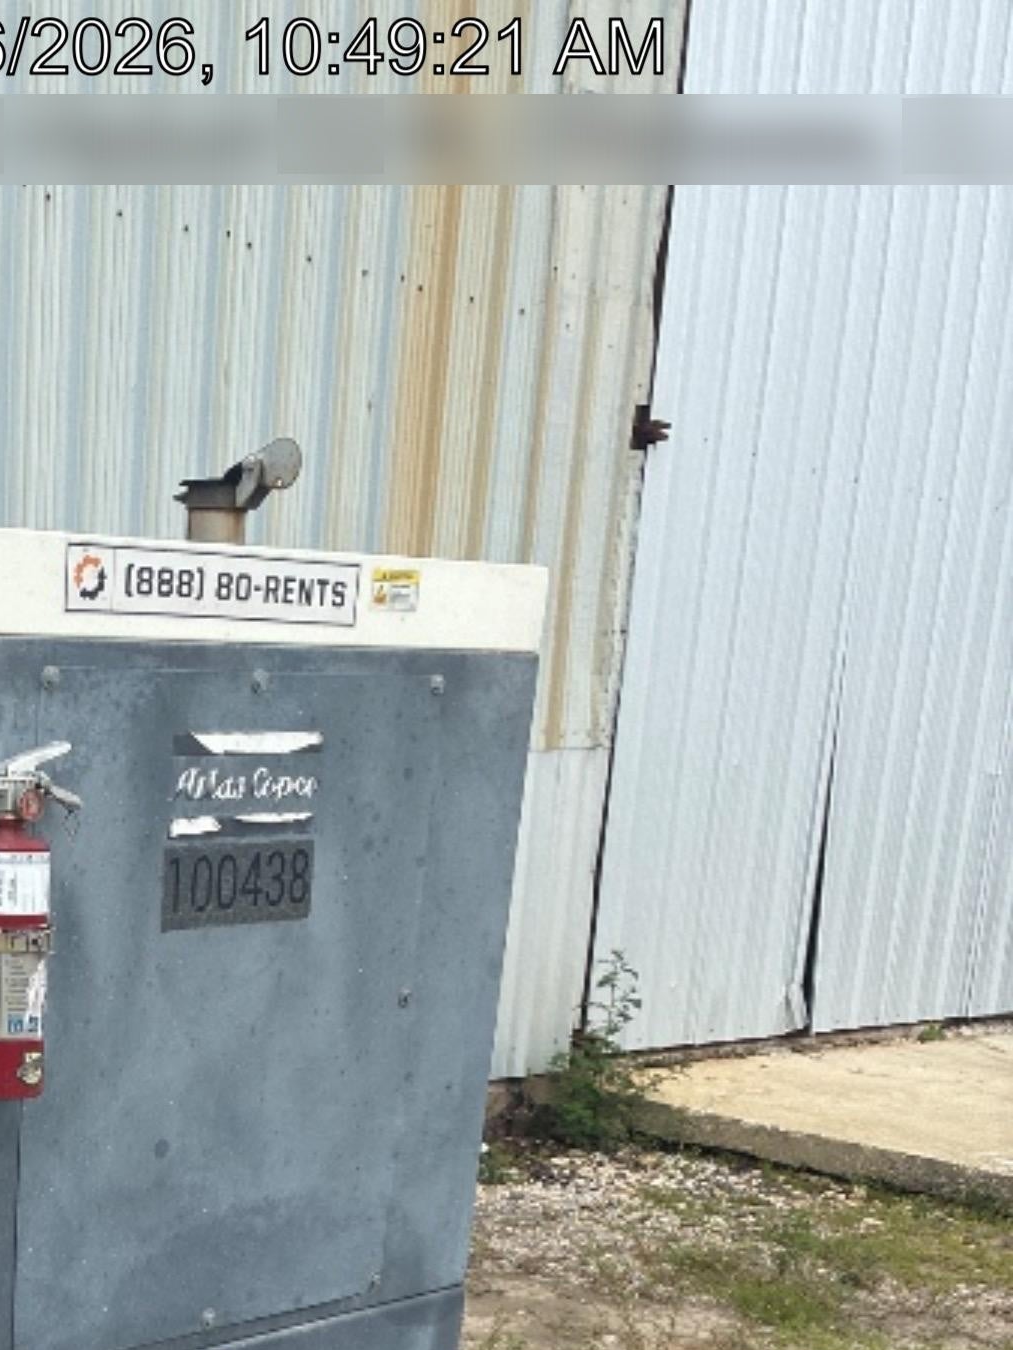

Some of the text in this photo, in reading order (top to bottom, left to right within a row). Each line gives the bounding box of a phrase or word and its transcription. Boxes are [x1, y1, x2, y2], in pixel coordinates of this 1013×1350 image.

[125, 564, 204, 599] (888)
[215, 572, 346, 607] 80-RENTS
[170, 849, 309, 913] 100438
